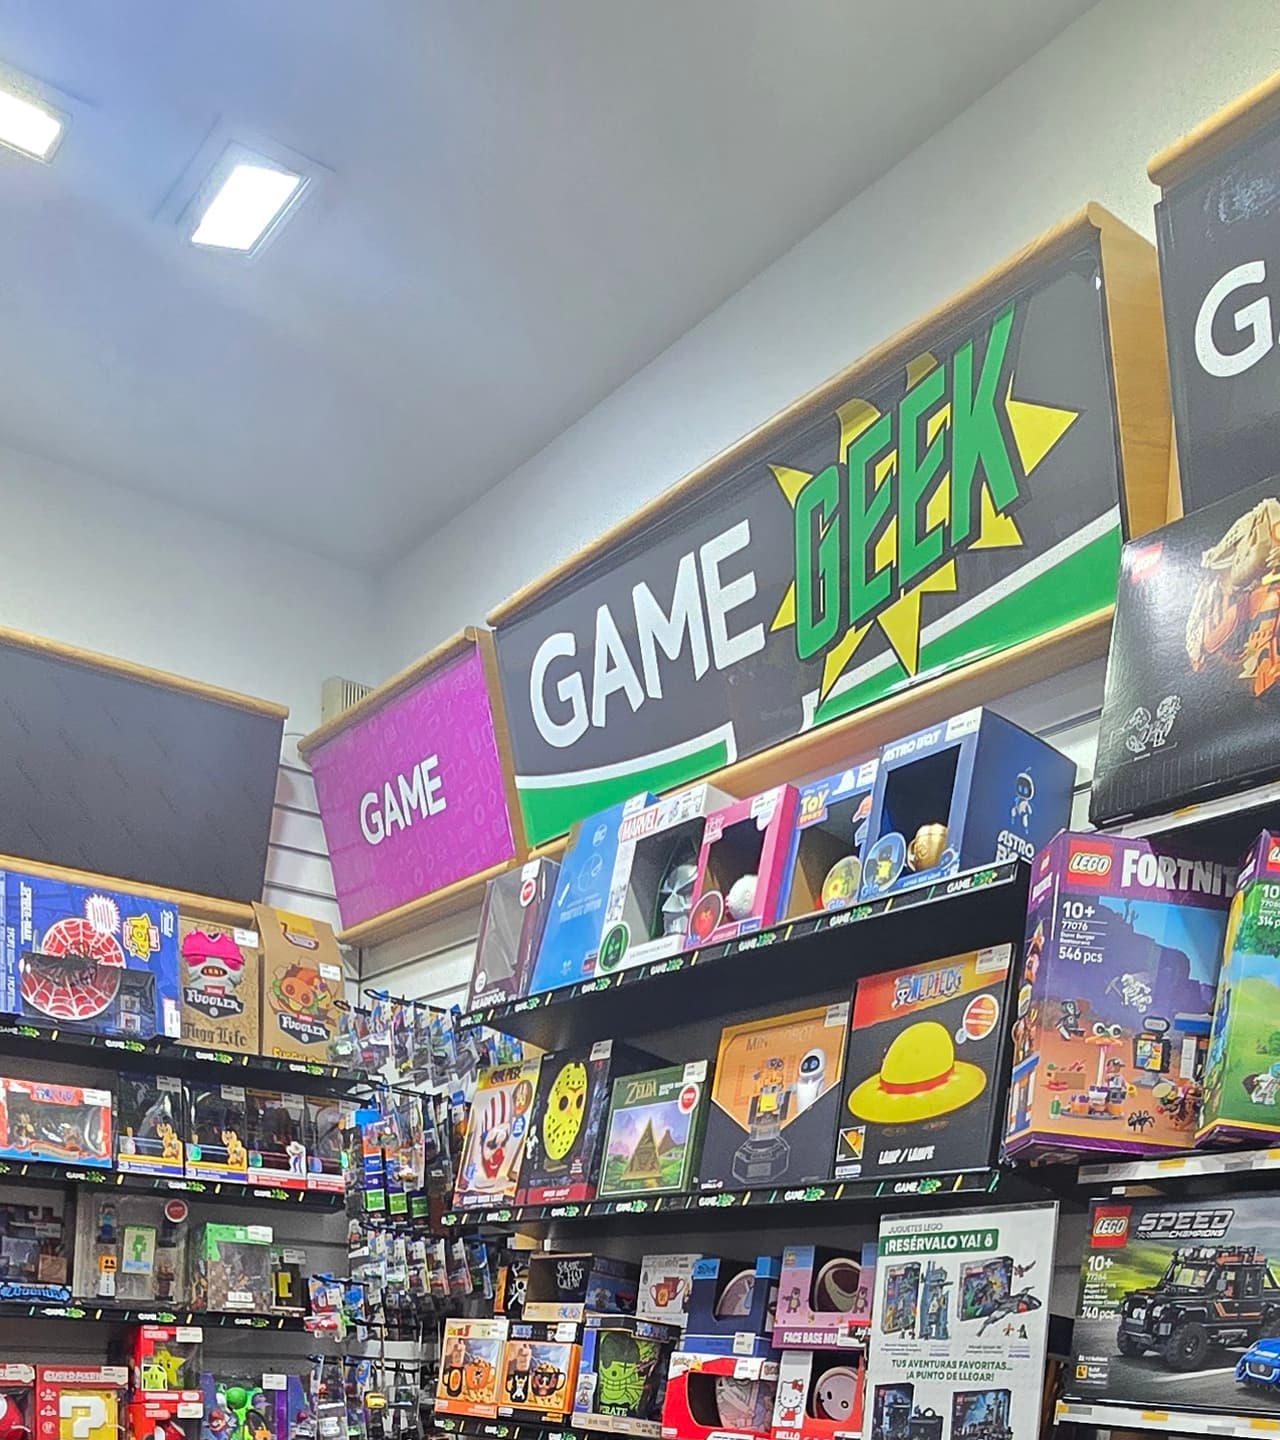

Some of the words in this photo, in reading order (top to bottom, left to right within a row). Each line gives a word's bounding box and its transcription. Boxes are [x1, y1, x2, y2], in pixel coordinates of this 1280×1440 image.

[530, 518, 767, 749] GAME
[793, 300, 1022, 660] GEEK
[360, 754, 446, 845] GAME
[801, 790, 829, 816] TOY
[621, 806, 659, 841] MARVEL
[997, 830, 1034, 856] ASTRO
[947, 877, 972, 893] GAME
[1062, 902, 1096, 919] 10+
[1058, 948, 1081, 961] 546
[1083, 950, 1103, 964] pcs
[220, 1025, 248, 1047] Life
[885, 1236, 958, 1255] ¡RESÉRVALO
[960, 1233, 981, 1249] YA!
[783, 1332, 802, 1344] FACE
[803, 1332, 823, 1344] BASE
[892, 1360, 906, 1368] TUS
[908, 1359, 957, 1369] AVENTURAS
[916, 1372, 945, 1380] PUNTO
[946, 1372, 958, 1380] DE
[959, 1373, 994, 1382] LLEGAR!
[775, 1431, 800, 1440] HELLO
